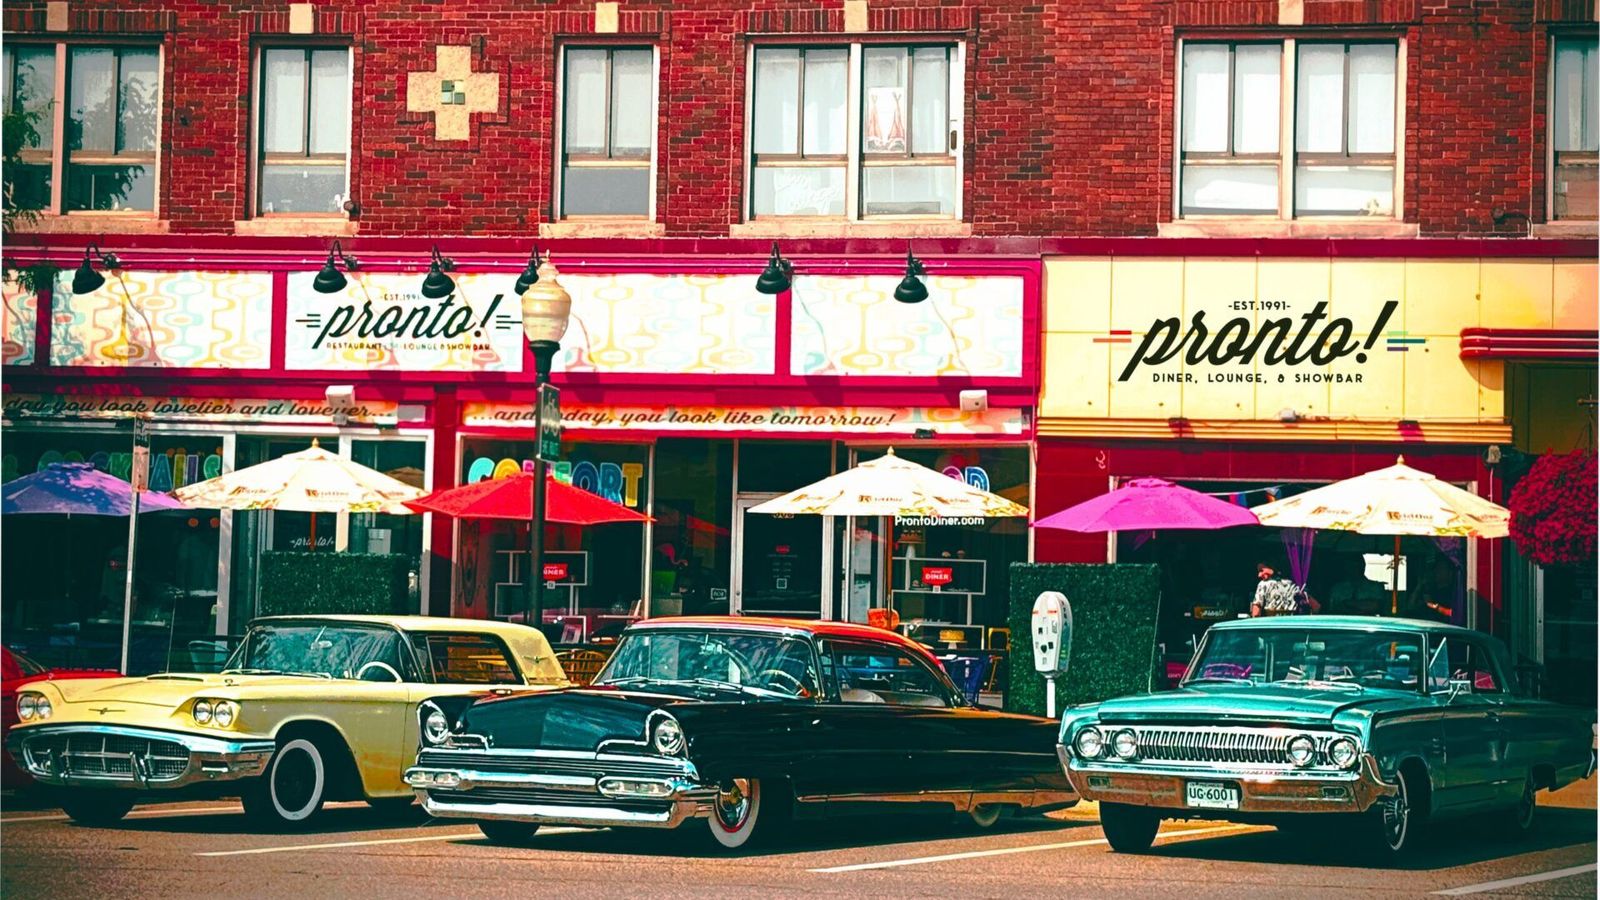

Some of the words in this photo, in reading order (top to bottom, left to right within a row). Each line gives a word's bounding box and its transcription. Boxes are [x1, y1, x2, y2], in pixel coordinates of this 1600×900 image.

[312, 294, 503, 349] pronto!
[1118, 300, 1399, 382] pronto!
[1153, 373, 1198, 384] DINER,
[1208, 373, 1267, 384] LOUNGE,
[1295, 373, 1363, 383] SHOWBAR
[100, 400, 148, 413] look
[153, 401, 236, 414] lovelier
[239, 401, 284, 415] and
[620, 411, 663, 427] you
[668, 410, 719, 424] look
[723, 410, 767, 424] like
[771, 411, 897, 426] tomorrow!
[468, 457, 643, 507] COFORT
[895, 514, 984, 527] ProntoDiner.com
